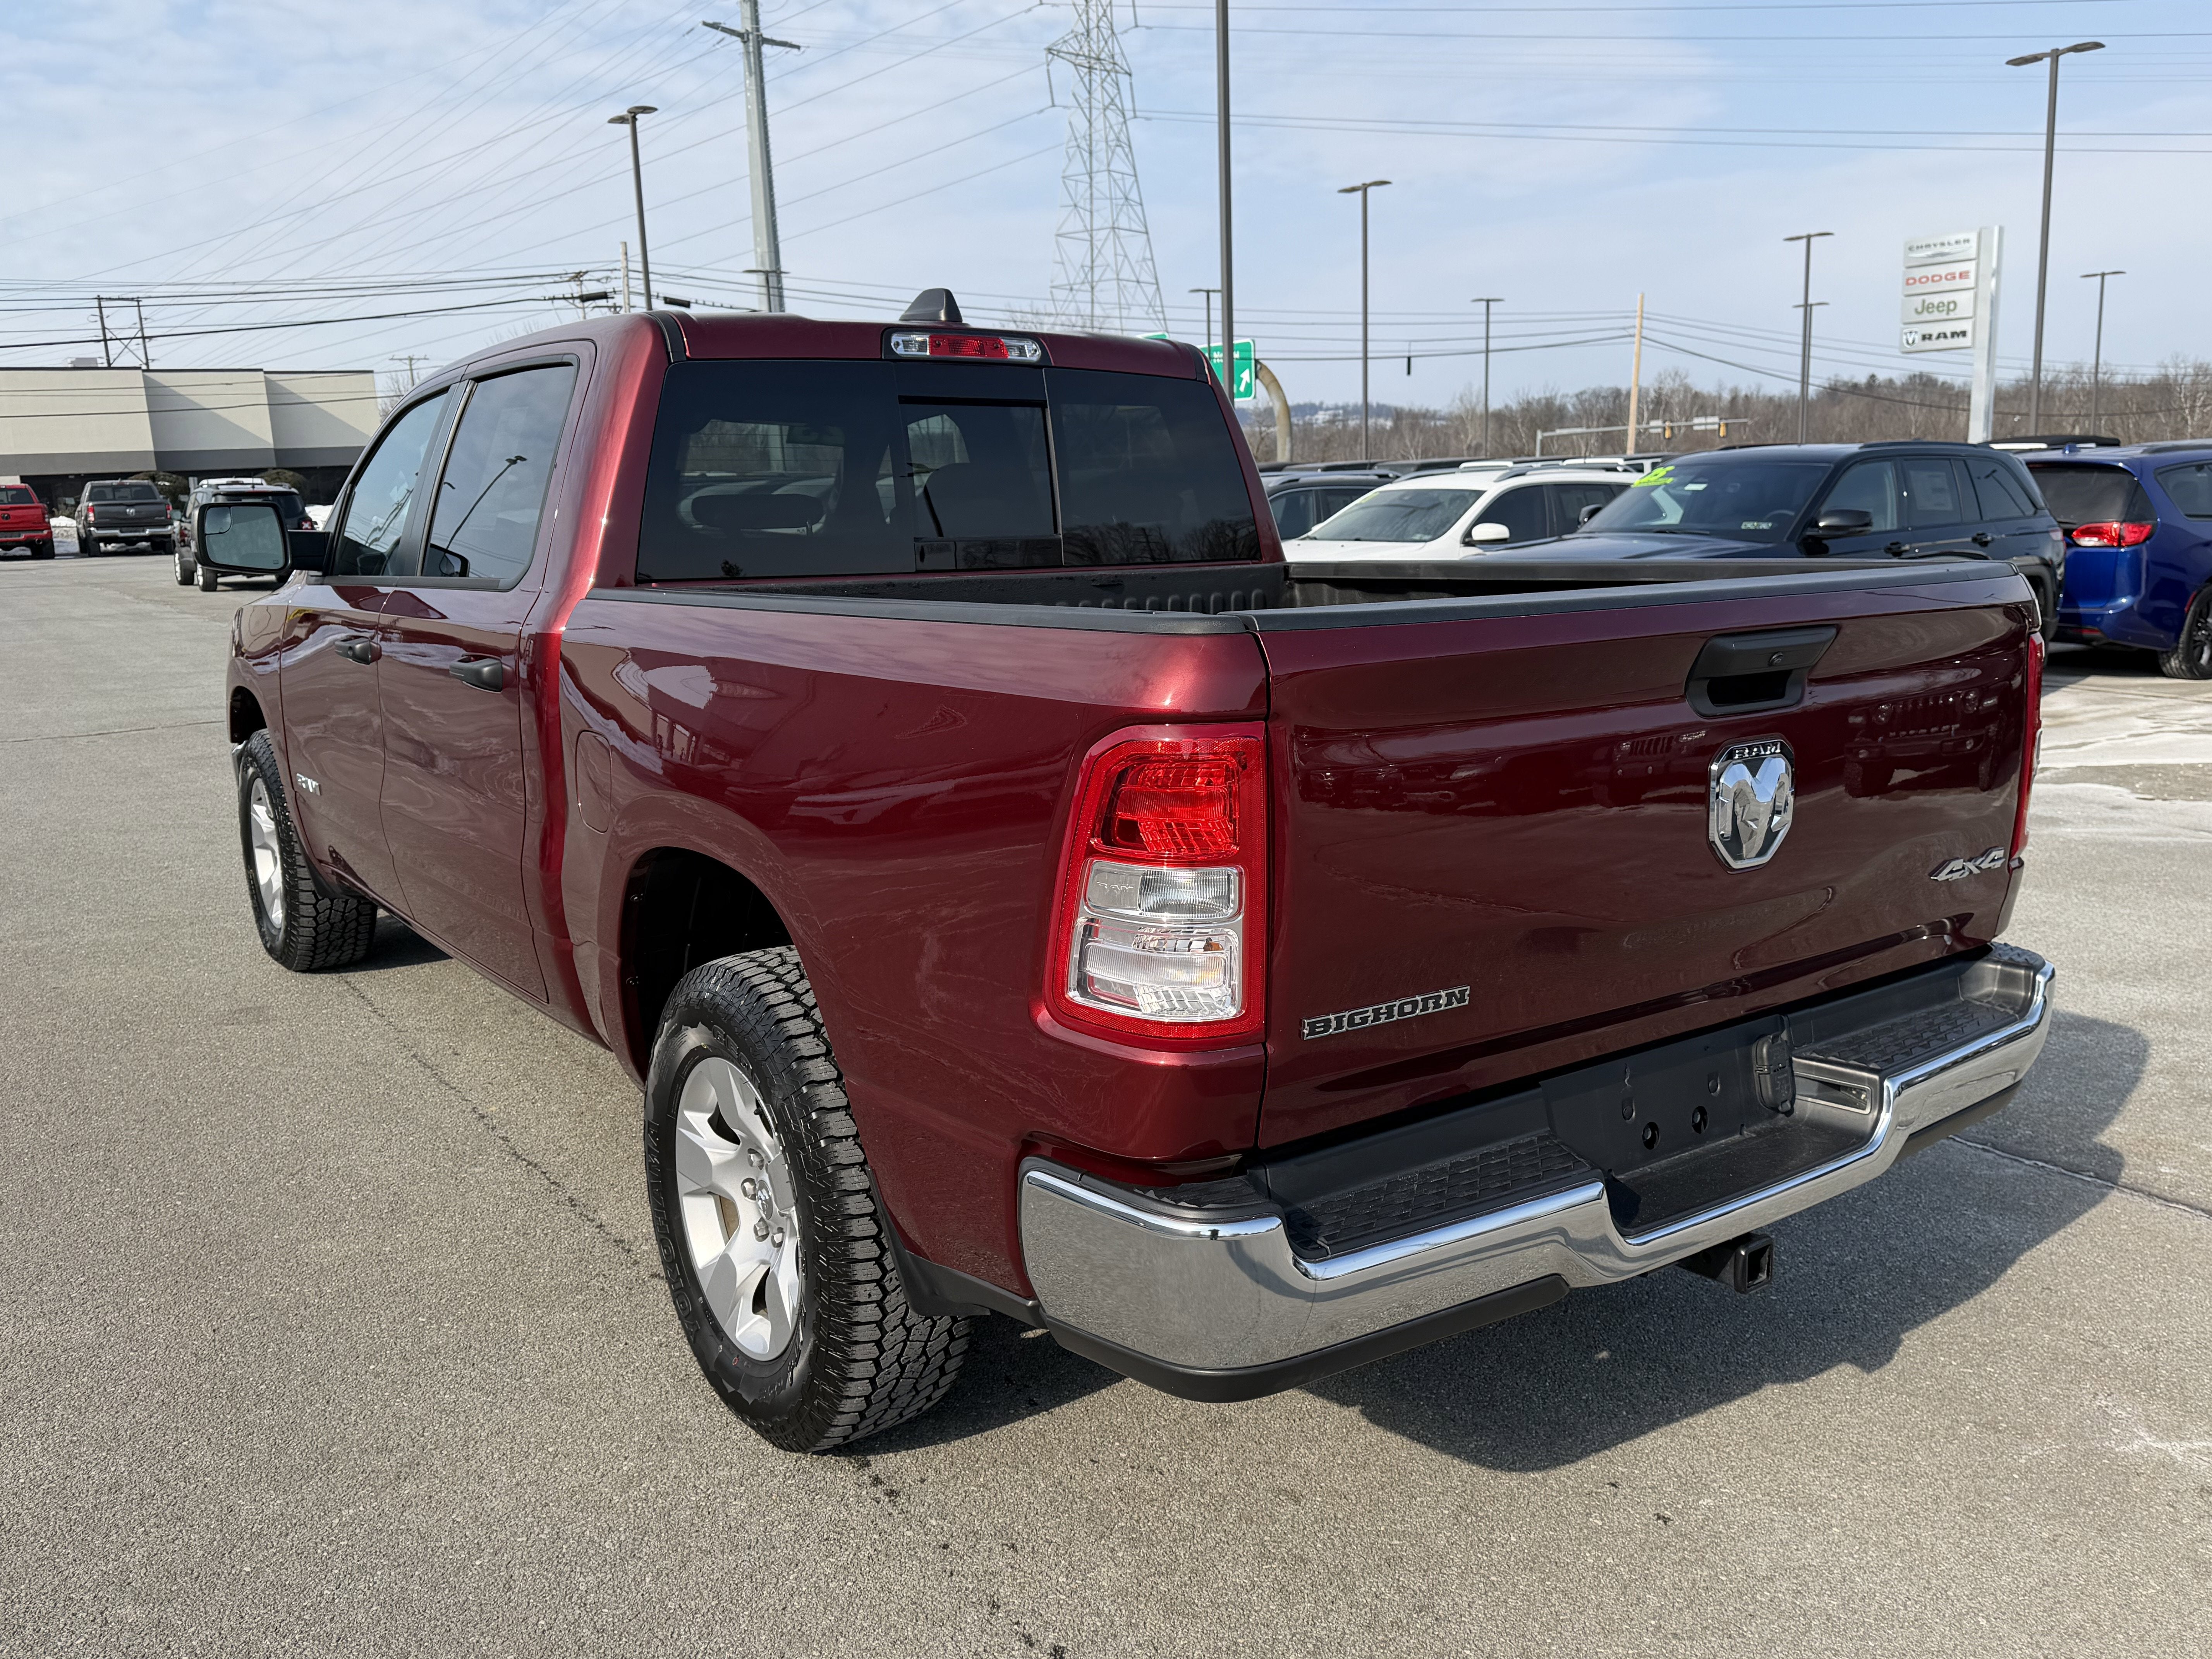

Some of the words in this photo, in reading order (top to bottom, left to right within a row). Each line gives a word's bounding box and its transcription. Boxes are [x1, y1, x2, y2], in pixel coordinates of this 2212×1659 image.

[1908, 238, 1971, 252] CHRYSLER
[1905, 270, 1970, 287] DODGE
[1914, 299, 1958, 315] Jeep
[1921, 330, 1967, 342] RAM
[1733, 742, 1781, 759] RAM
[1300, 984, 1470, 1041] BIGHORN
